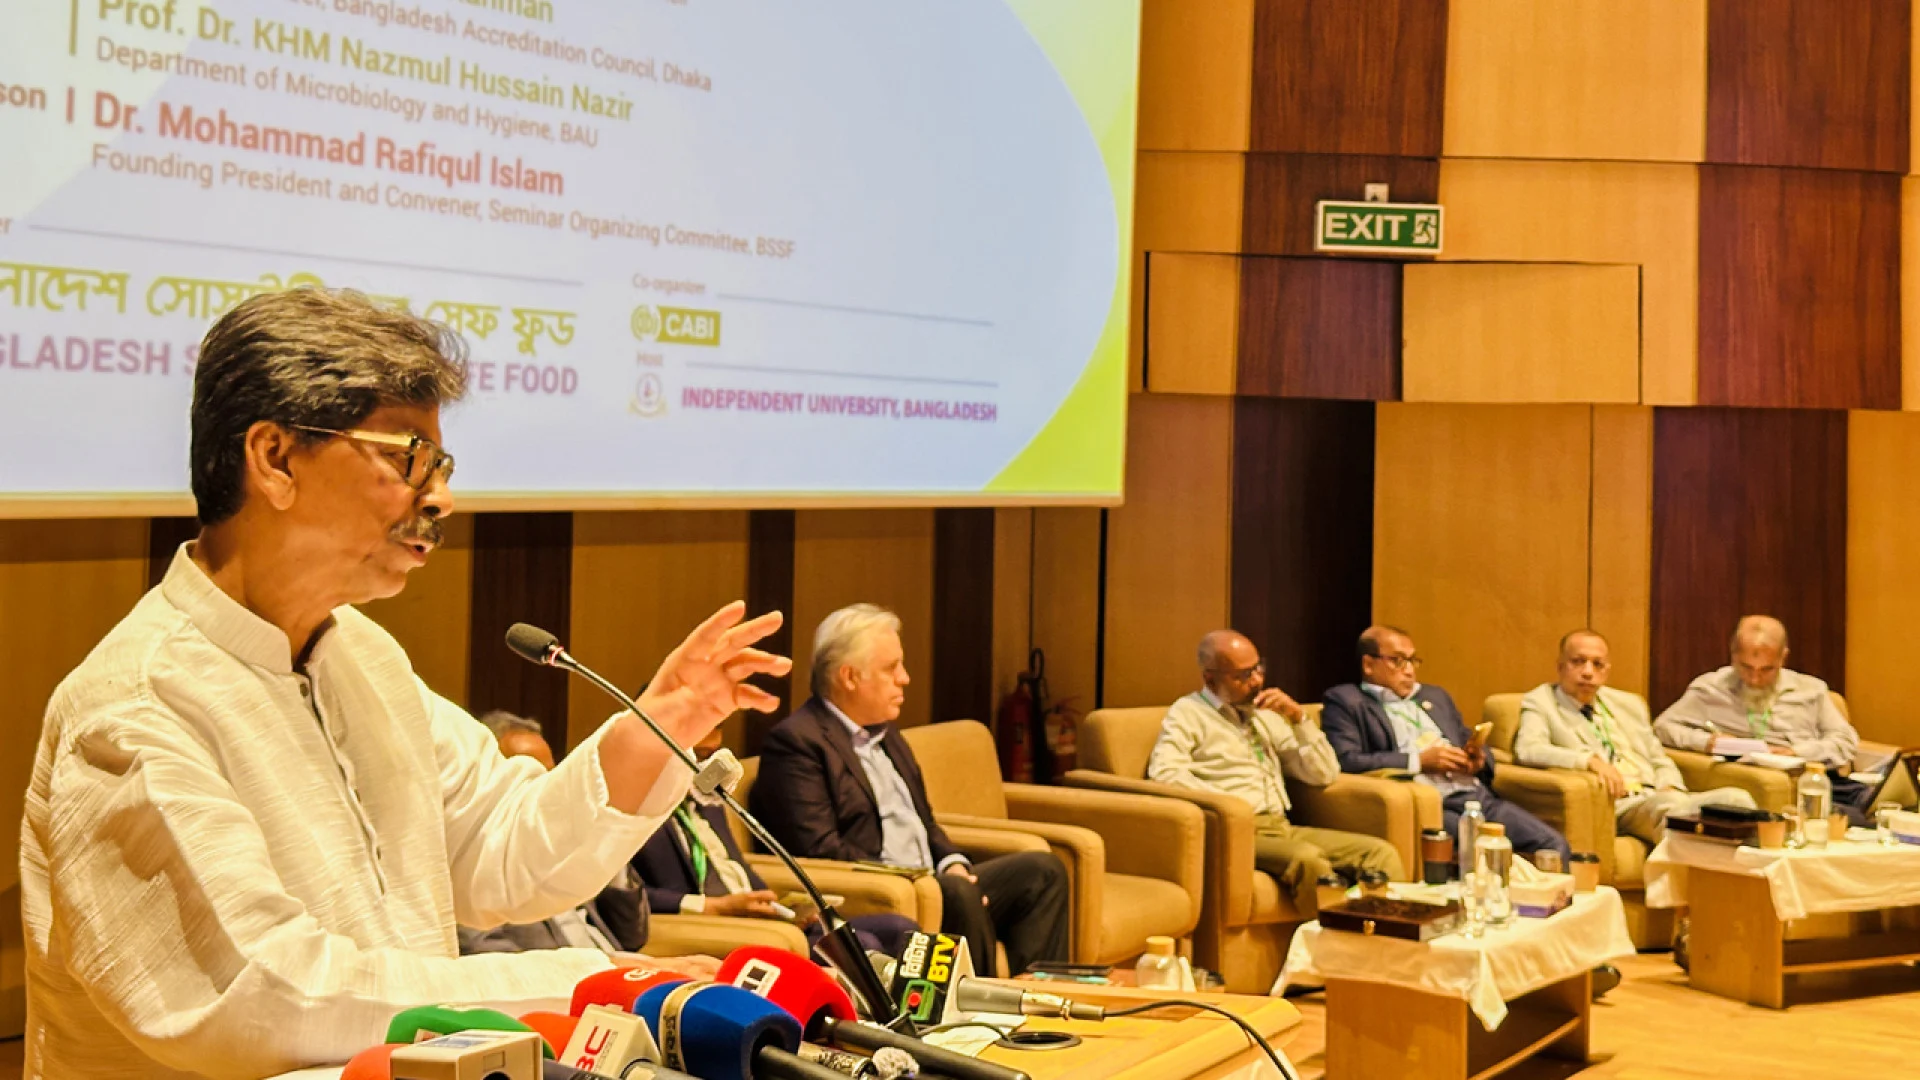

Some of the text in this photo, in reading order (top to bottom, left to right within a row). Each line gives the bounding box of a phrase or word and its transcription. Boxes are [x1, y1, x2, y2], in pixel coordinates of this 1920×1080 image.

[460, 0, 553, 21] man
[98, 0, 634, 121] Prof. Dr. KHM Nazmul Hussain Nazir
[333, 0, 712, 92] Bangladesh Accreditation Council, Dhaka
[97, 36, 599, 148] Department of Microbiology and Hygiene, BAU
[94, 91, 564, 196] Dr. Mohammad Rafiqul Islam
[92, 144, 797, 259] Founding President and Convener, Seminar Organizing Committee, BSSF
[1325, 212, 1408, 241] EXIT
[665, 312, 715, 340] CABI
[504, 363, 578, 394] FOOD
[682, 386, 997, 422] INDEPENDENT UNIVERSITY, BANGLADESH
[927, 933, 956, 983] BTV
